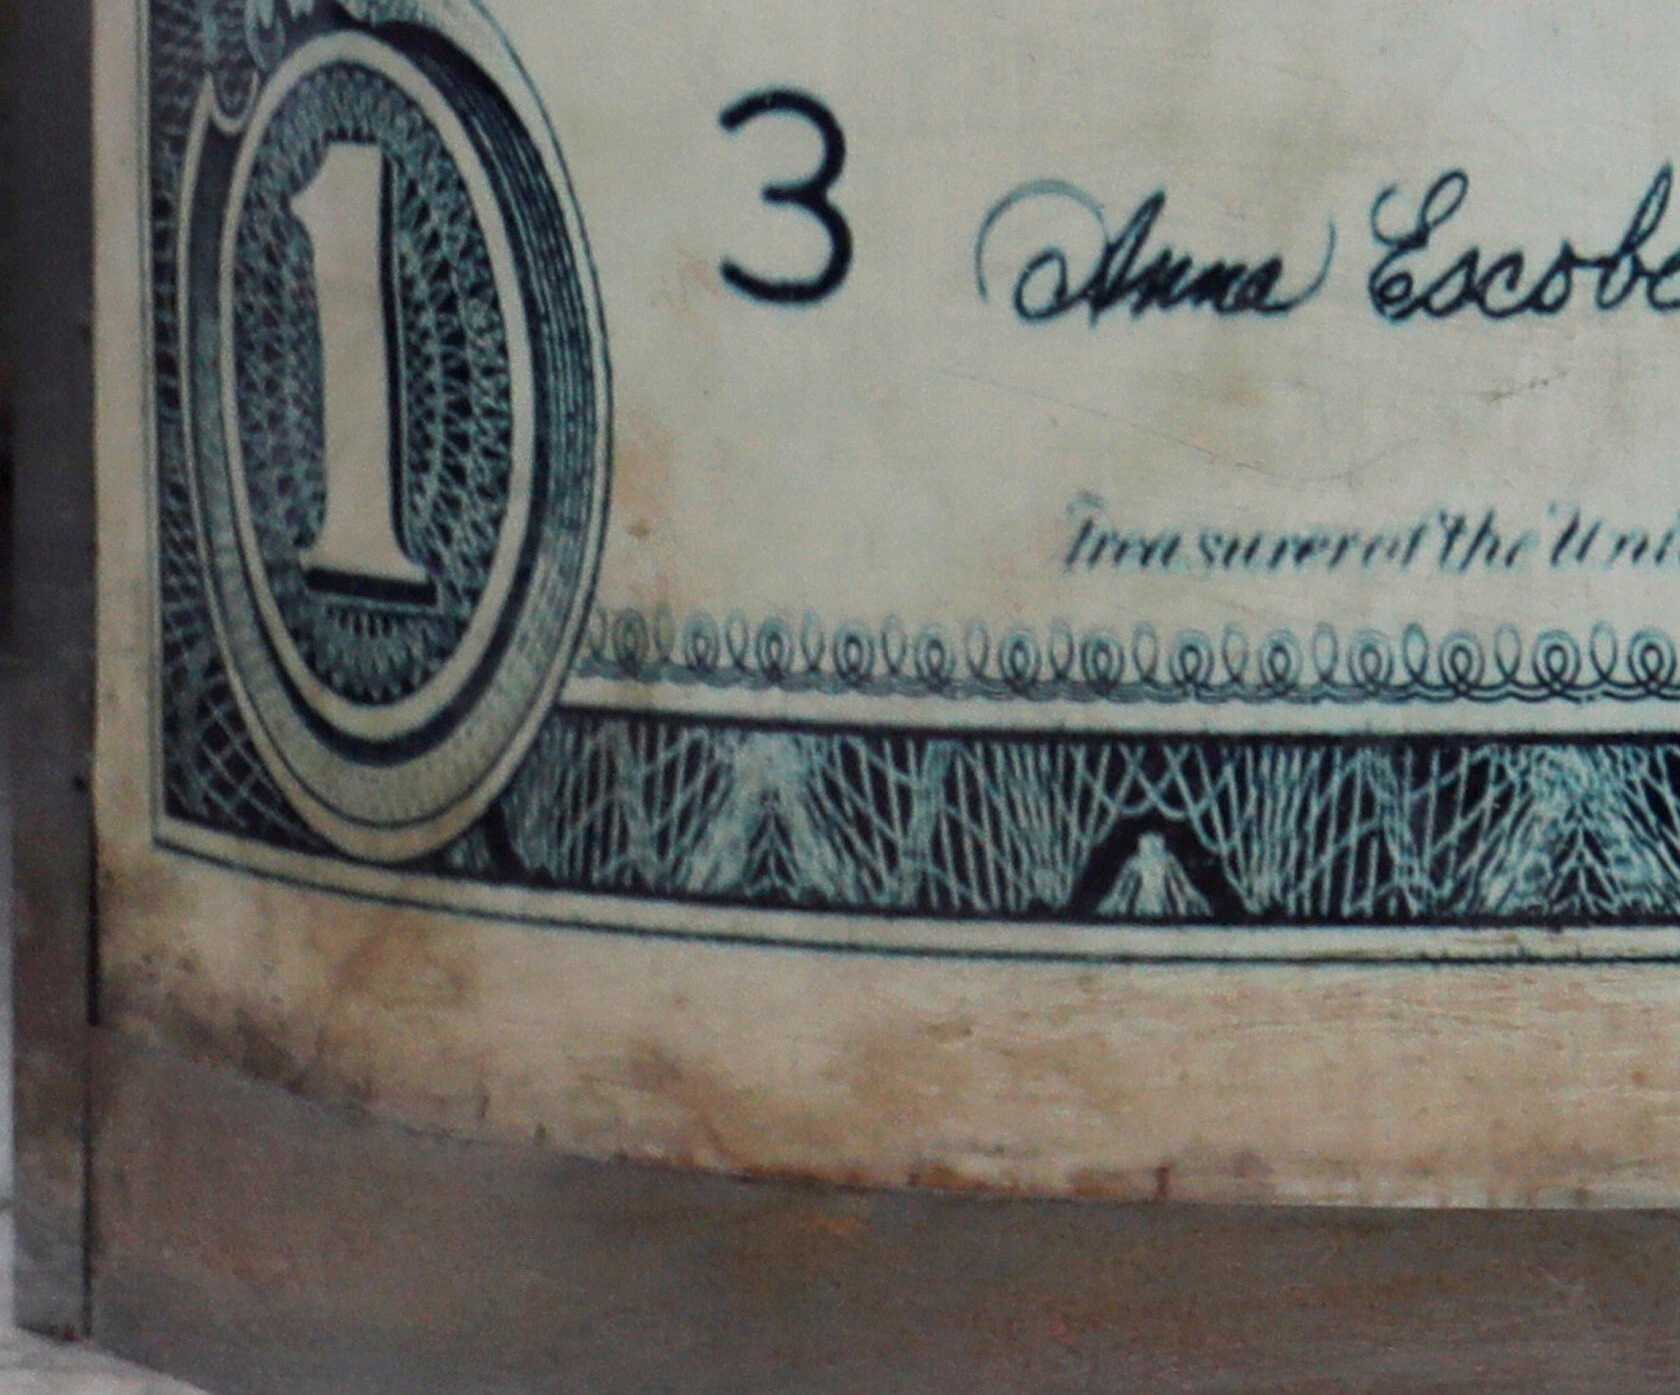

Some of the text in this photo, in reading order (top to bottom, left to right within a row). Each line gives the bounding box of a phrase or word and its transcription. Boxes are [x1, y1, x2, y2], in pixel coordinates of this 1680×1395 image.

[716, 86, 856, 310] 3
[1064, 492, 1376, 572] Treasurer
[1442, 507, 1529, 572] the
